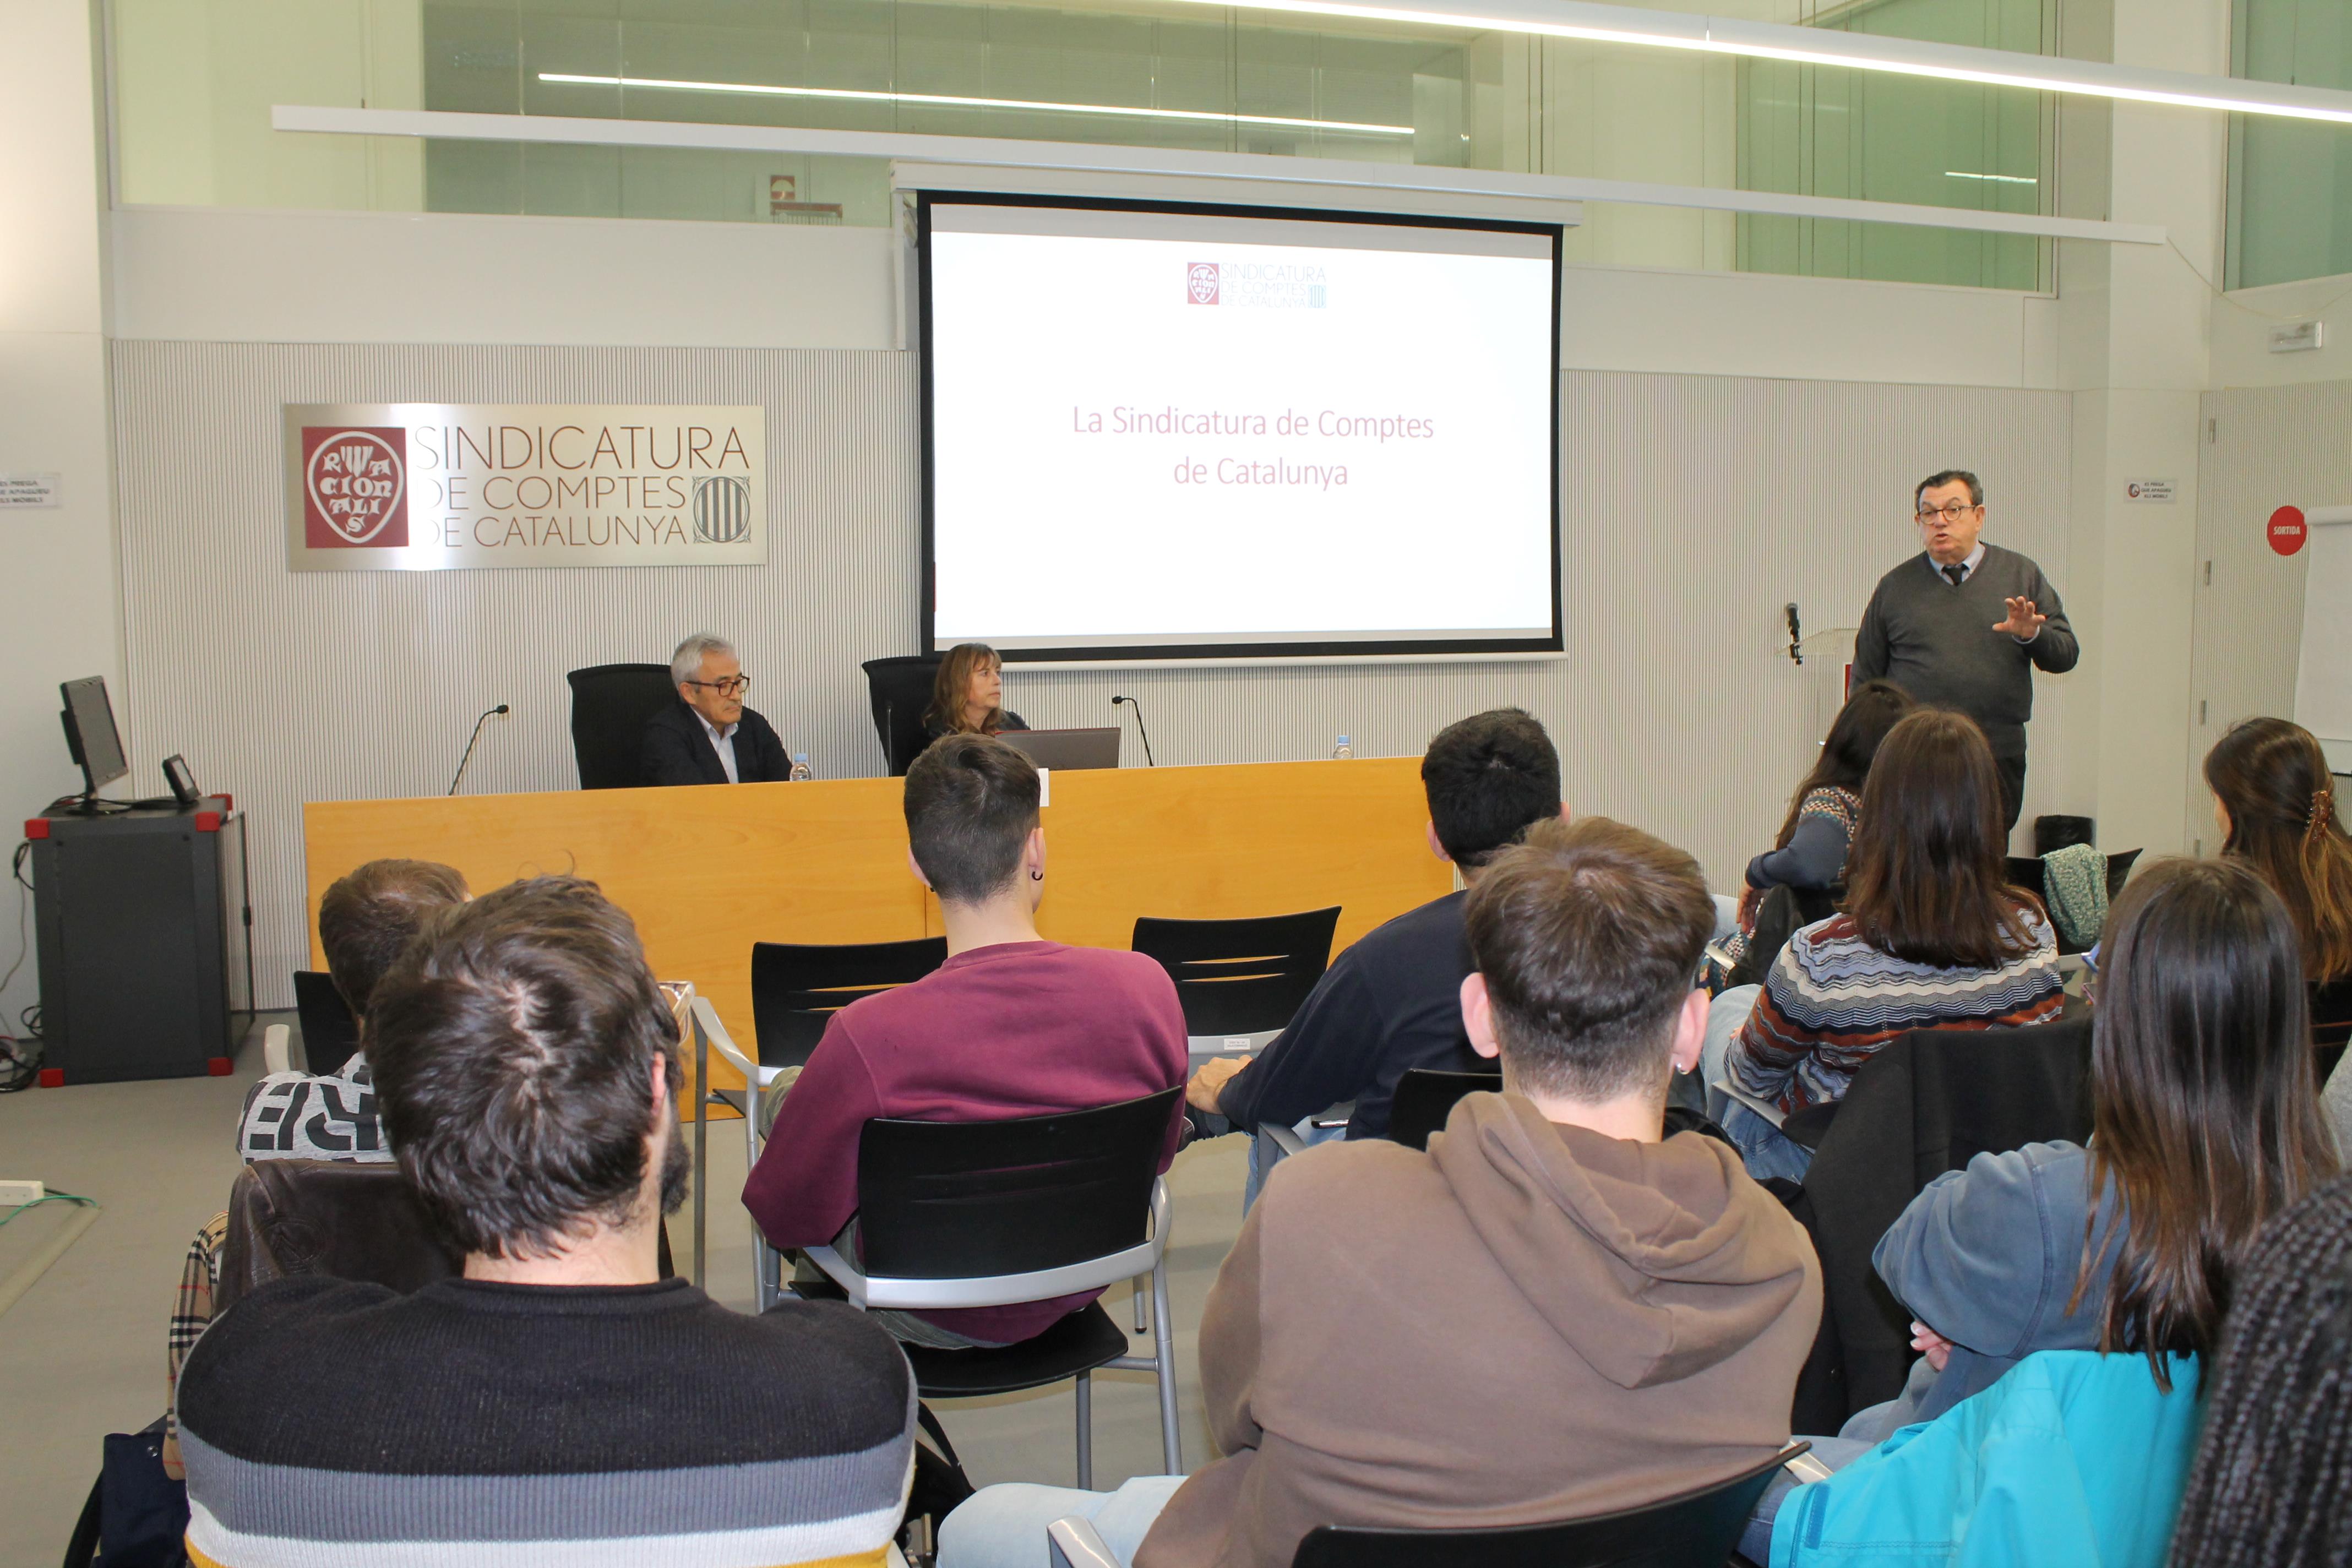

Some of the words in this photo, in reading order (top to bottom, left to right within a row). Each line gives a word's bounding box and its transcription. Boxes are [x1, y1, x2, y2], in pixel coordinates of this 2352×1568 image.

[1221, 263, 1326, 282] SINDICATURA
[1221, 281, 1238, 293] DE
[1242, 281, 1306, 296] COMPTES
[1221, 295, 1235, 307] DE
[1239, 295, 1306, 309] CATALUNYA
[1074, 406, 1103, 433] La
[1112, 406, 1267, 435] Sindicatura
[1276, 408, 1309, 436] de
[1318, 410, 1434, 444] Comptes
[415, 426, 750, 470] SINDICATURA
[1174, 455, 1208, 485] de
[1217, 456, 1348, 492] Catalunya
[417, 476, 470, 511] DE
[482, 475, 687, 510] COMPTES
[473, 515, 688, 547] CATALUNYA
[2273, 526, 2301, 535] SORTIDA
